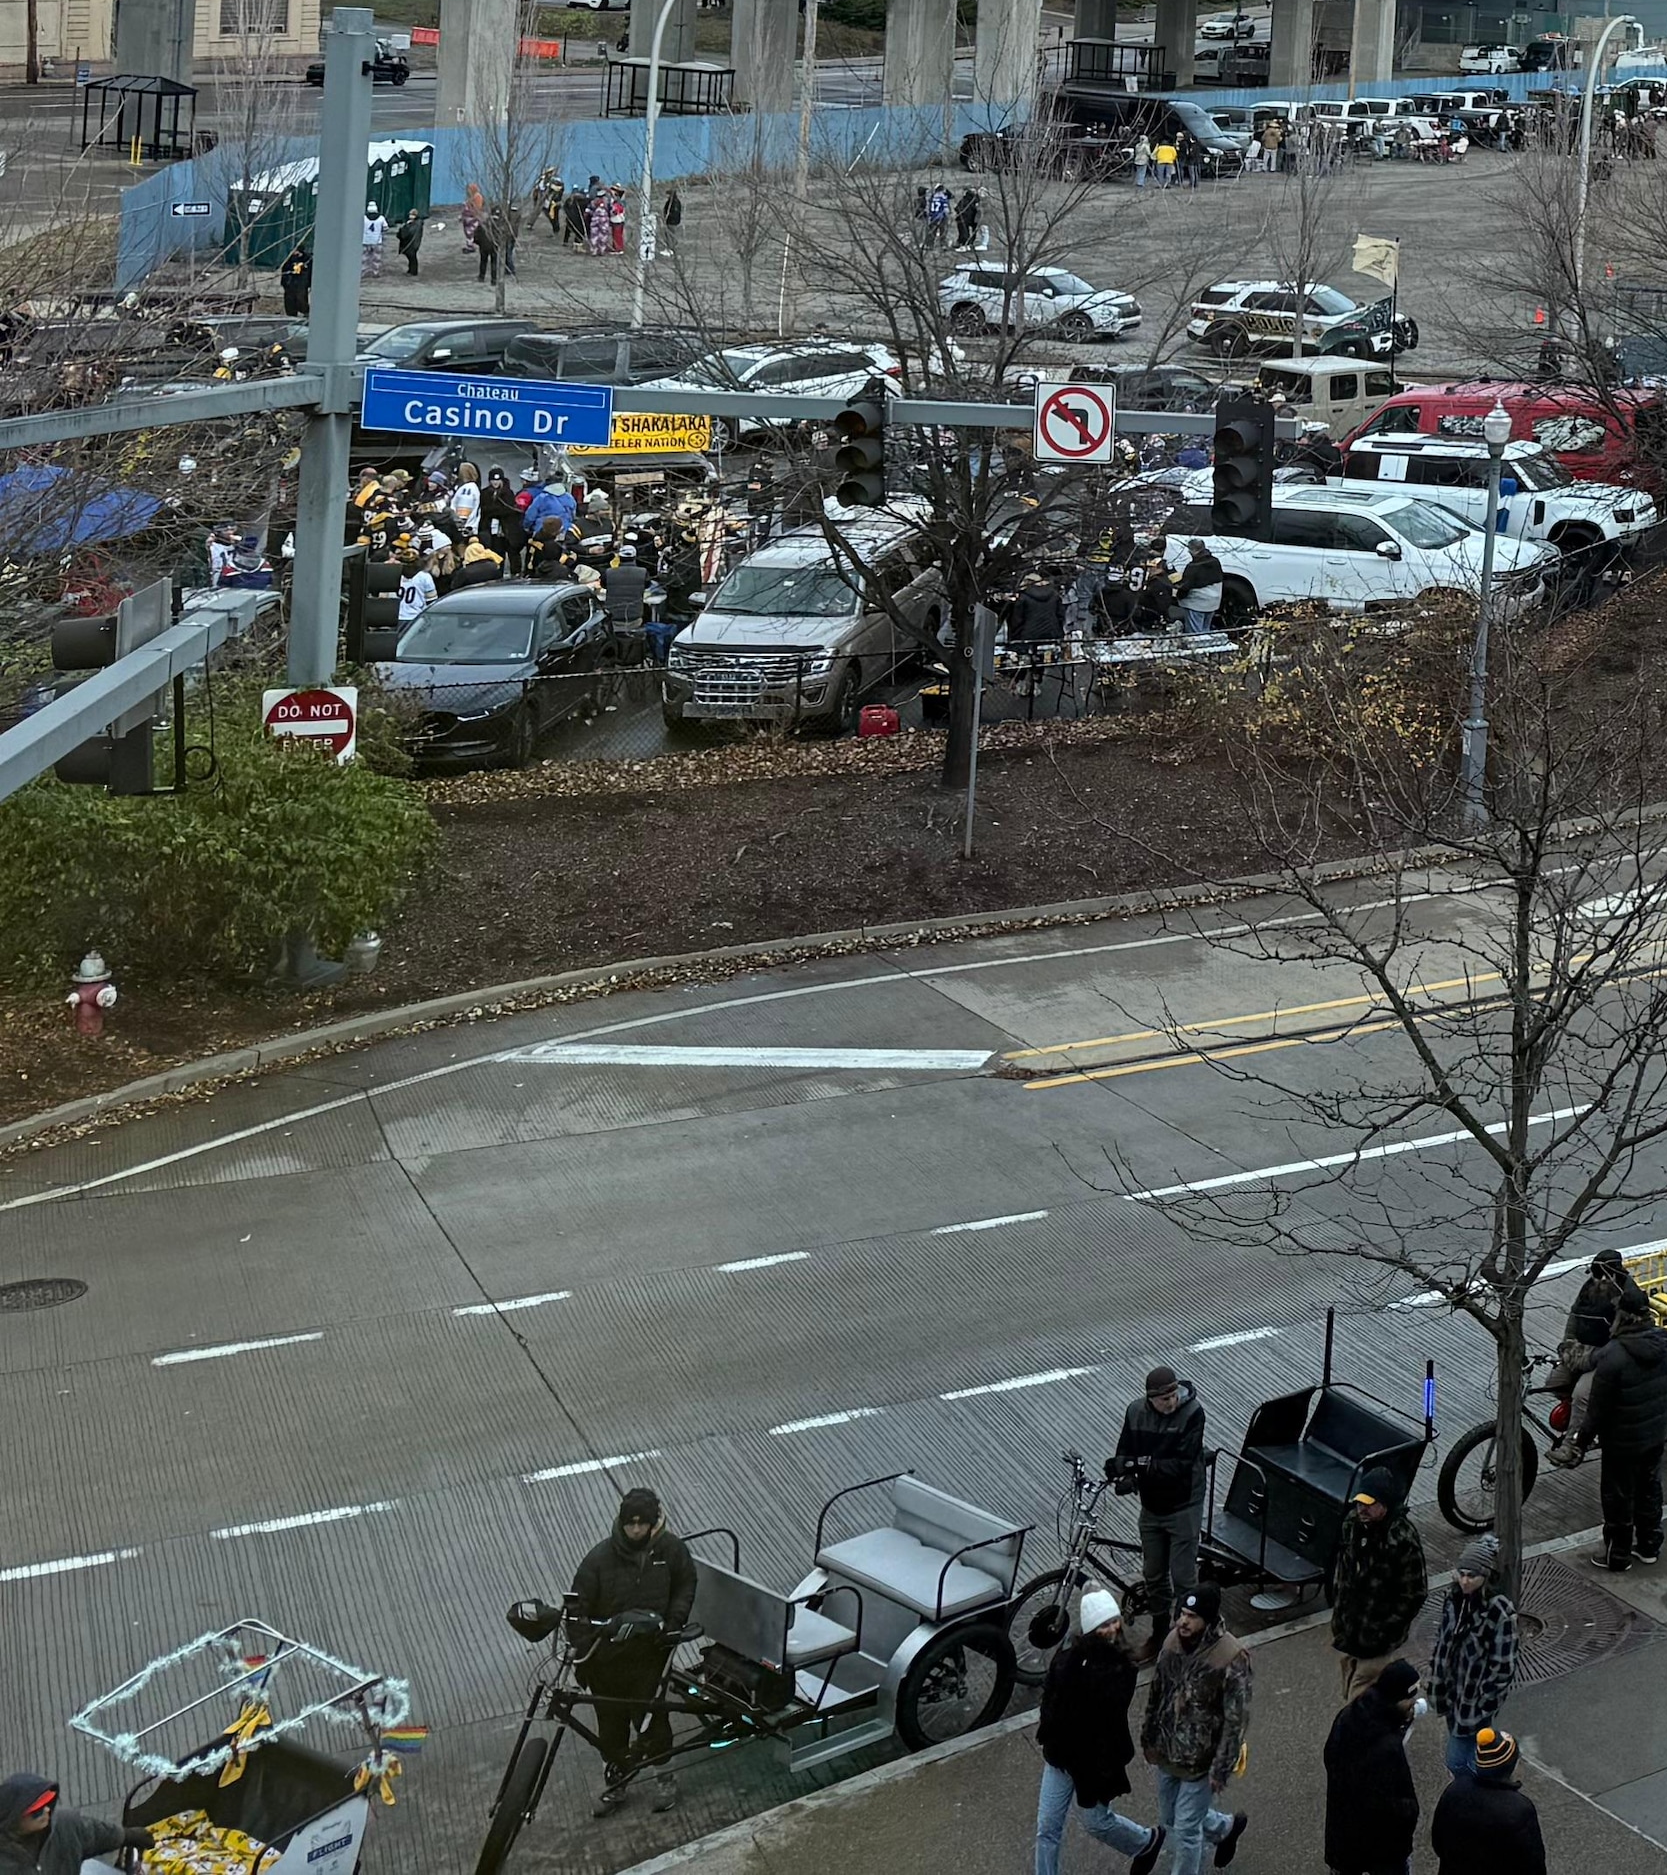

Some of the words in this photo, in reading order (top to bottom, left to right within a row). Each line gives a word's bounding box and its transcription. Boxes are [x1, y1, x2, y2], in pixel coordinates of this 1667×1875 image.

[930, 201, 942, 212] 17
[1244, 315, 1307, 335] POLIC
[456, 382, 519, 400] Chateau
[404, 400, 514, 431] Casino
[533, 409, 569, 435] Dr
[621, 416, 707, 433] SHAKALAKA
[609, 437, 641, 449] EELER
[645, 437, 686, 449] NATION
[278, 705, 300, 718] DO
[311, 703, 342, 717] NOT
